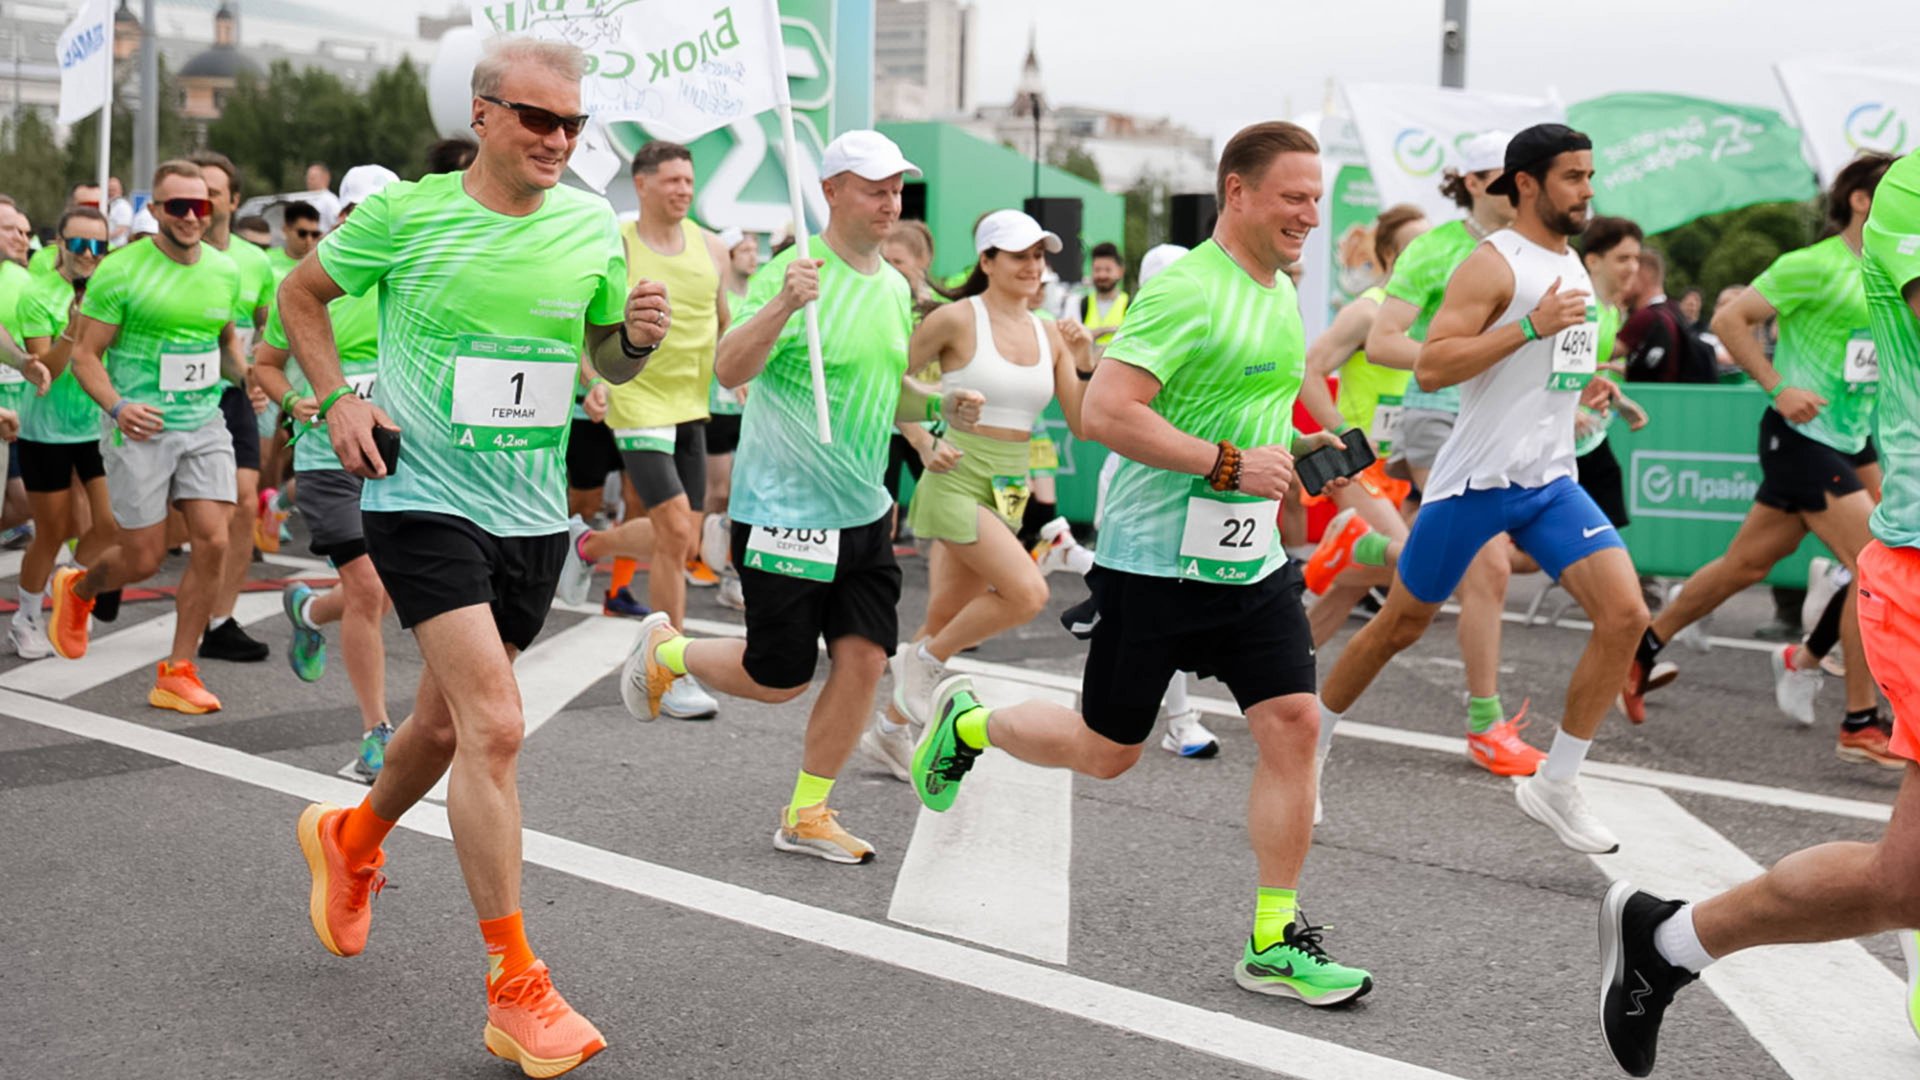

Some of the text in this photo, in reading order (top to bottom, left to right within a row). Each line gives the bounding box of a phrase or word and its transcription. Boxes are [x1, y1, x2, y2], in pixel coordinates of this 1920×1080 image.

[184, 363, 206, 382] 21
[510, 372, 525, 405] 1
[492, 407, 536, 419] ГЕРМАН
[1219, 517, 1256, 548] 22
[776, 541, 811, 553] СЕРГЕЙ
